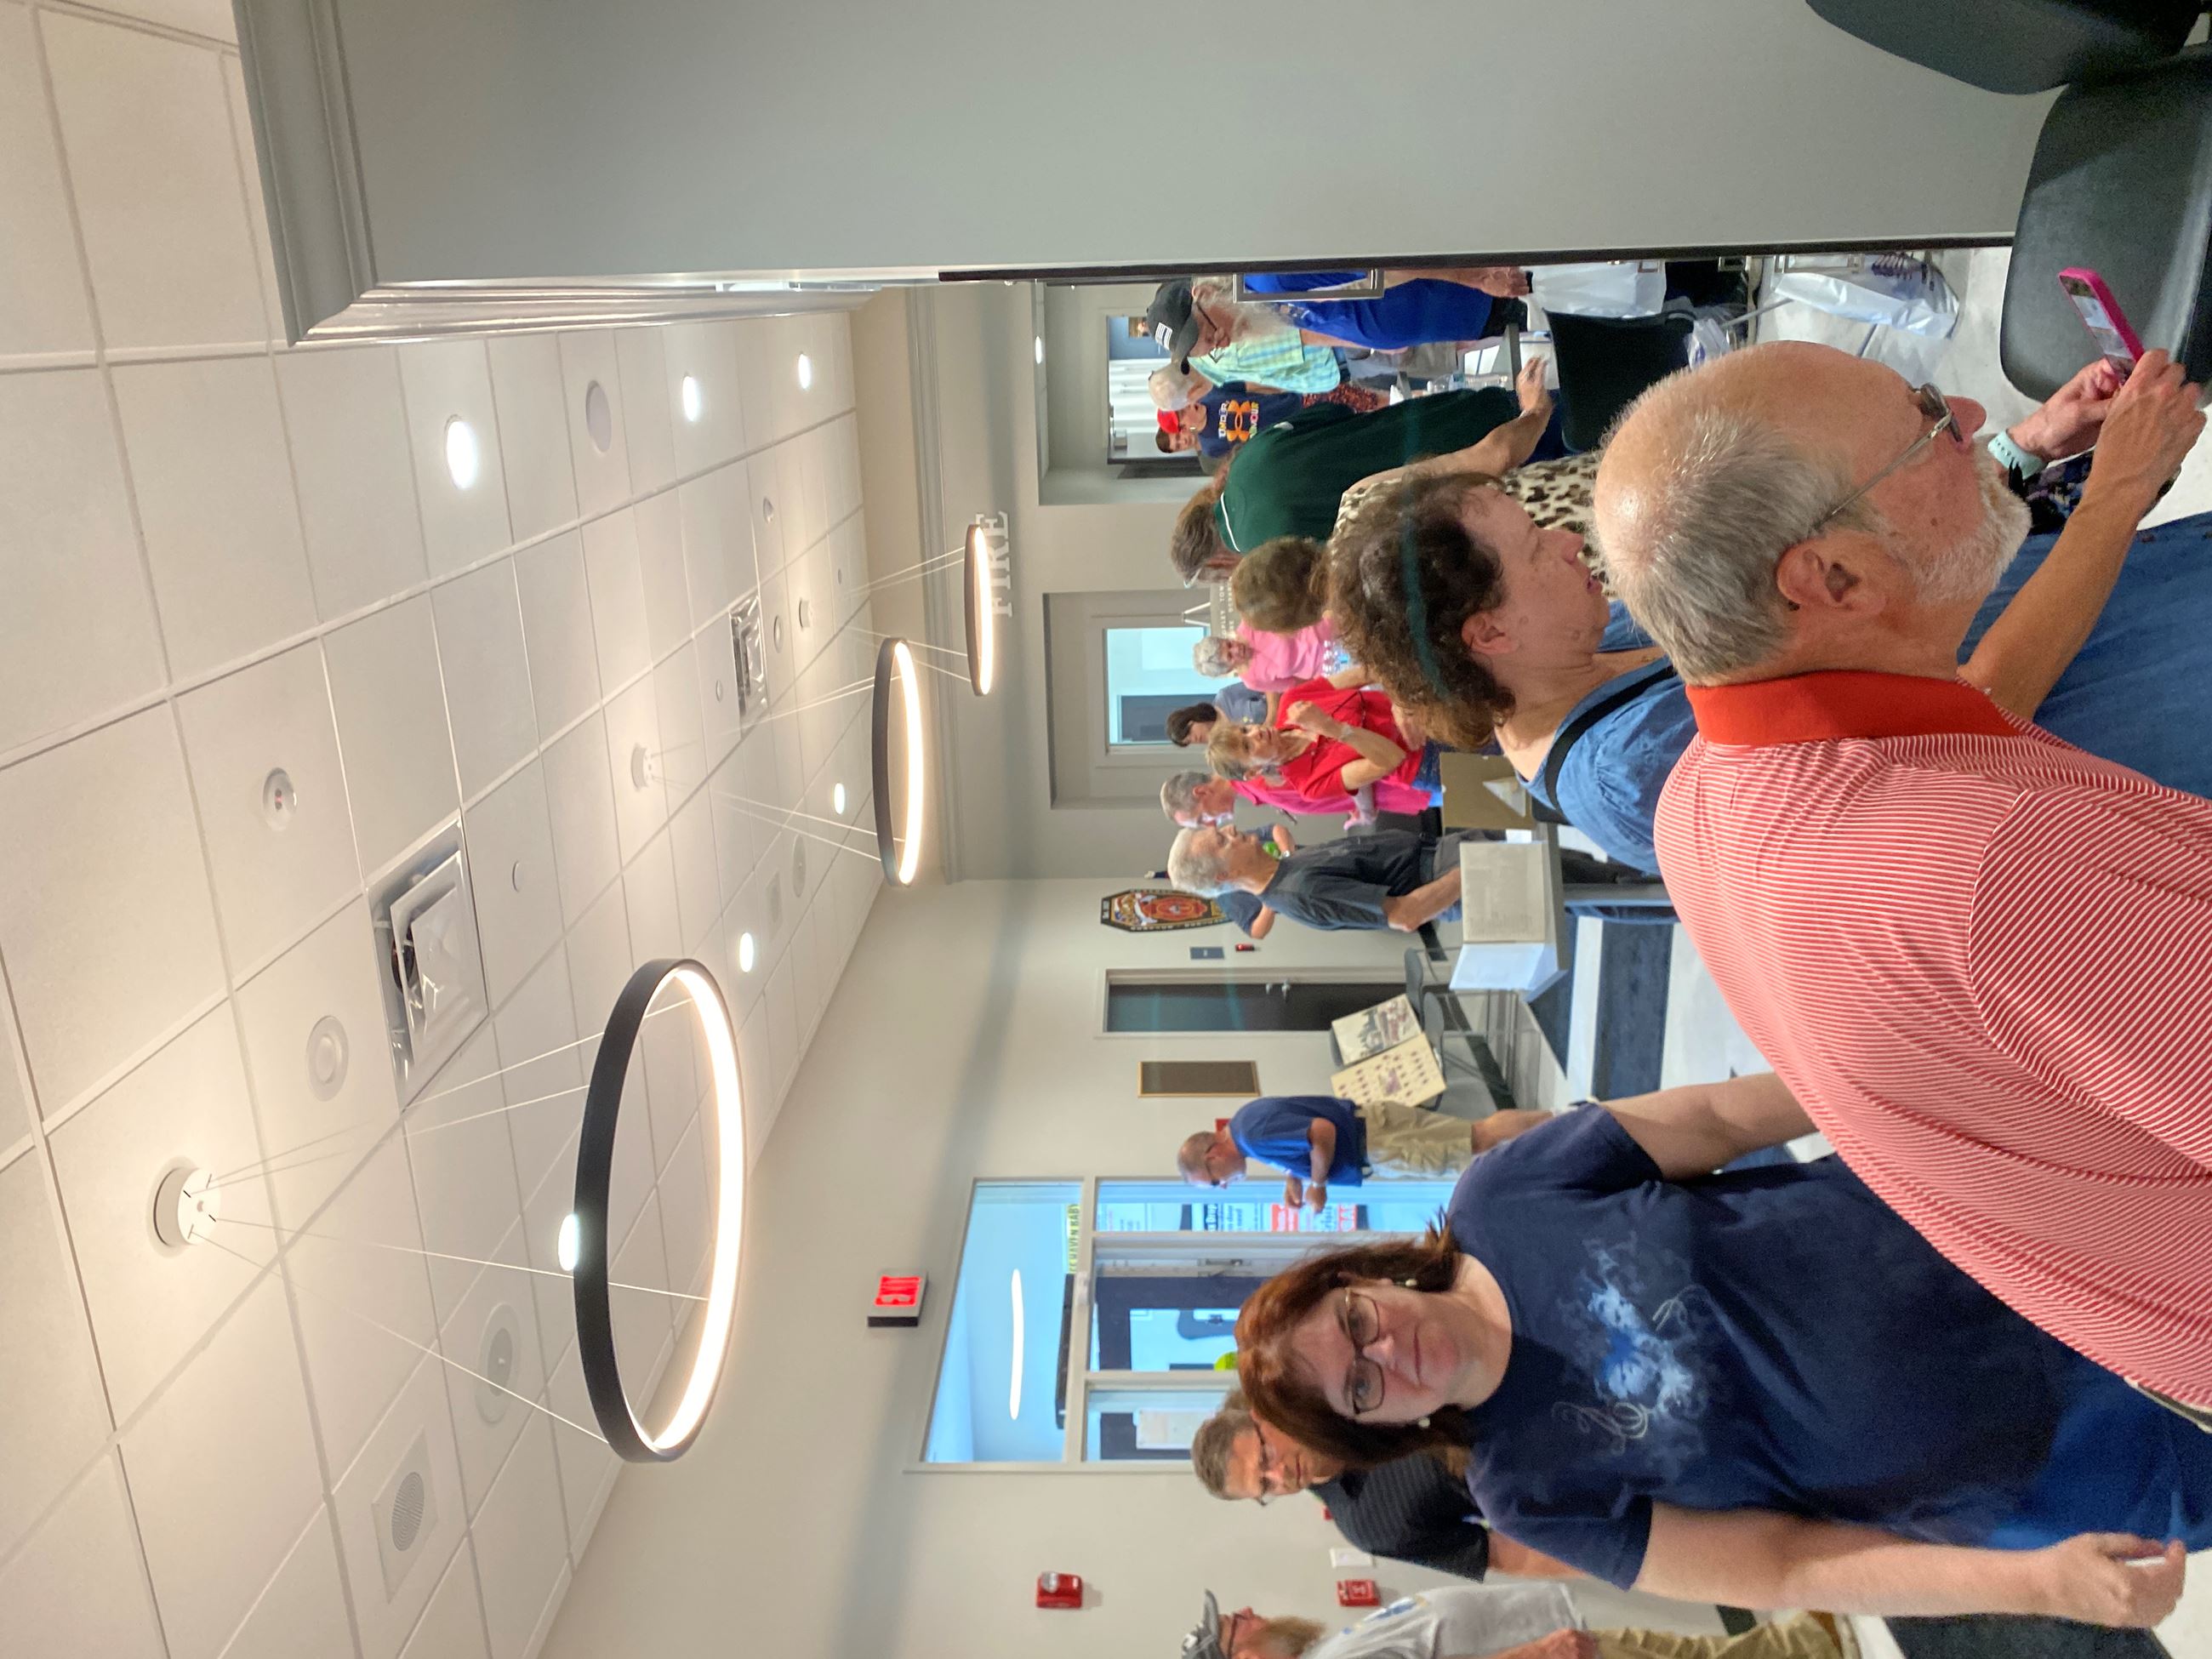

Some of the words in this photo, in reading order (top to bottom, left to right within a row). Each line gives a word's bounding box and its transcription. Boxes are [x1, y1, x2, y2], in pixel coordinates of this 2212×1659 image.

[1218, 401, 1229, 438] UNDER
[1248, 402, 1259, 439] RMOUR
[976, 510, 1012, 618] FIRE
[1320, 1205, 1332, 1231] risis
[874, 1275, 921, 1306] EXIT
